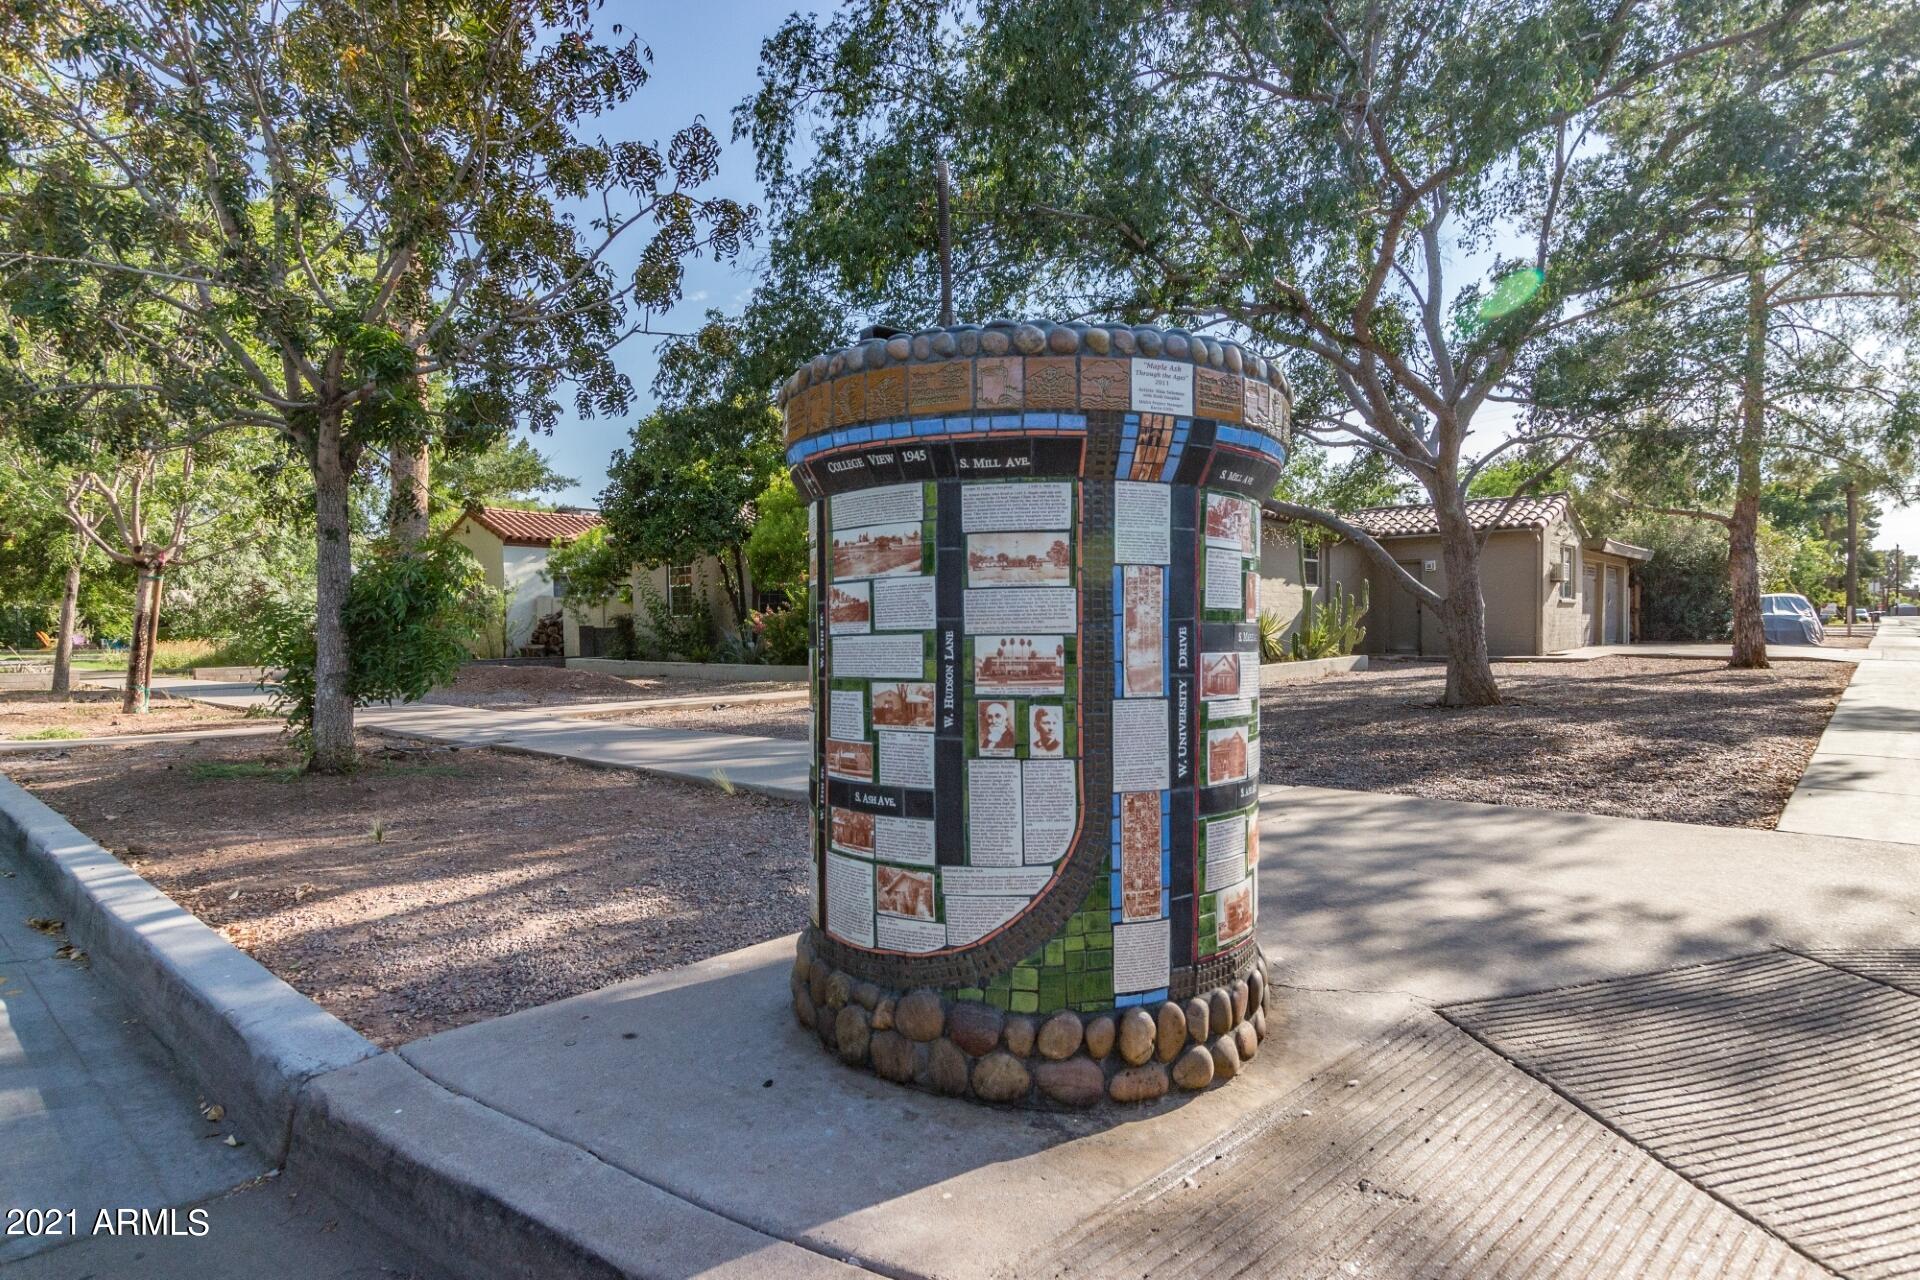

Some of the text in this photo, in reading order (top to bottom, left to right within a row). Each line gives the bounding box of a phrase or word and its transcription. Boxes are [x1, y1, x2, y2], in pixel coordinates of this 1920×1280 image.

[827, 449, 927, 473] COLLEGE VIEW 1945
[960, 458, 969, 468] S.
[973, 457, 1001, 469] MILL
[943, 630, 954, 661] LANE
[1178, 626, 1188, 669] DRIVE
[943, 664, 954, 709] HUDSON
[1178, 680, 1188, 758] UNIVERSITY
